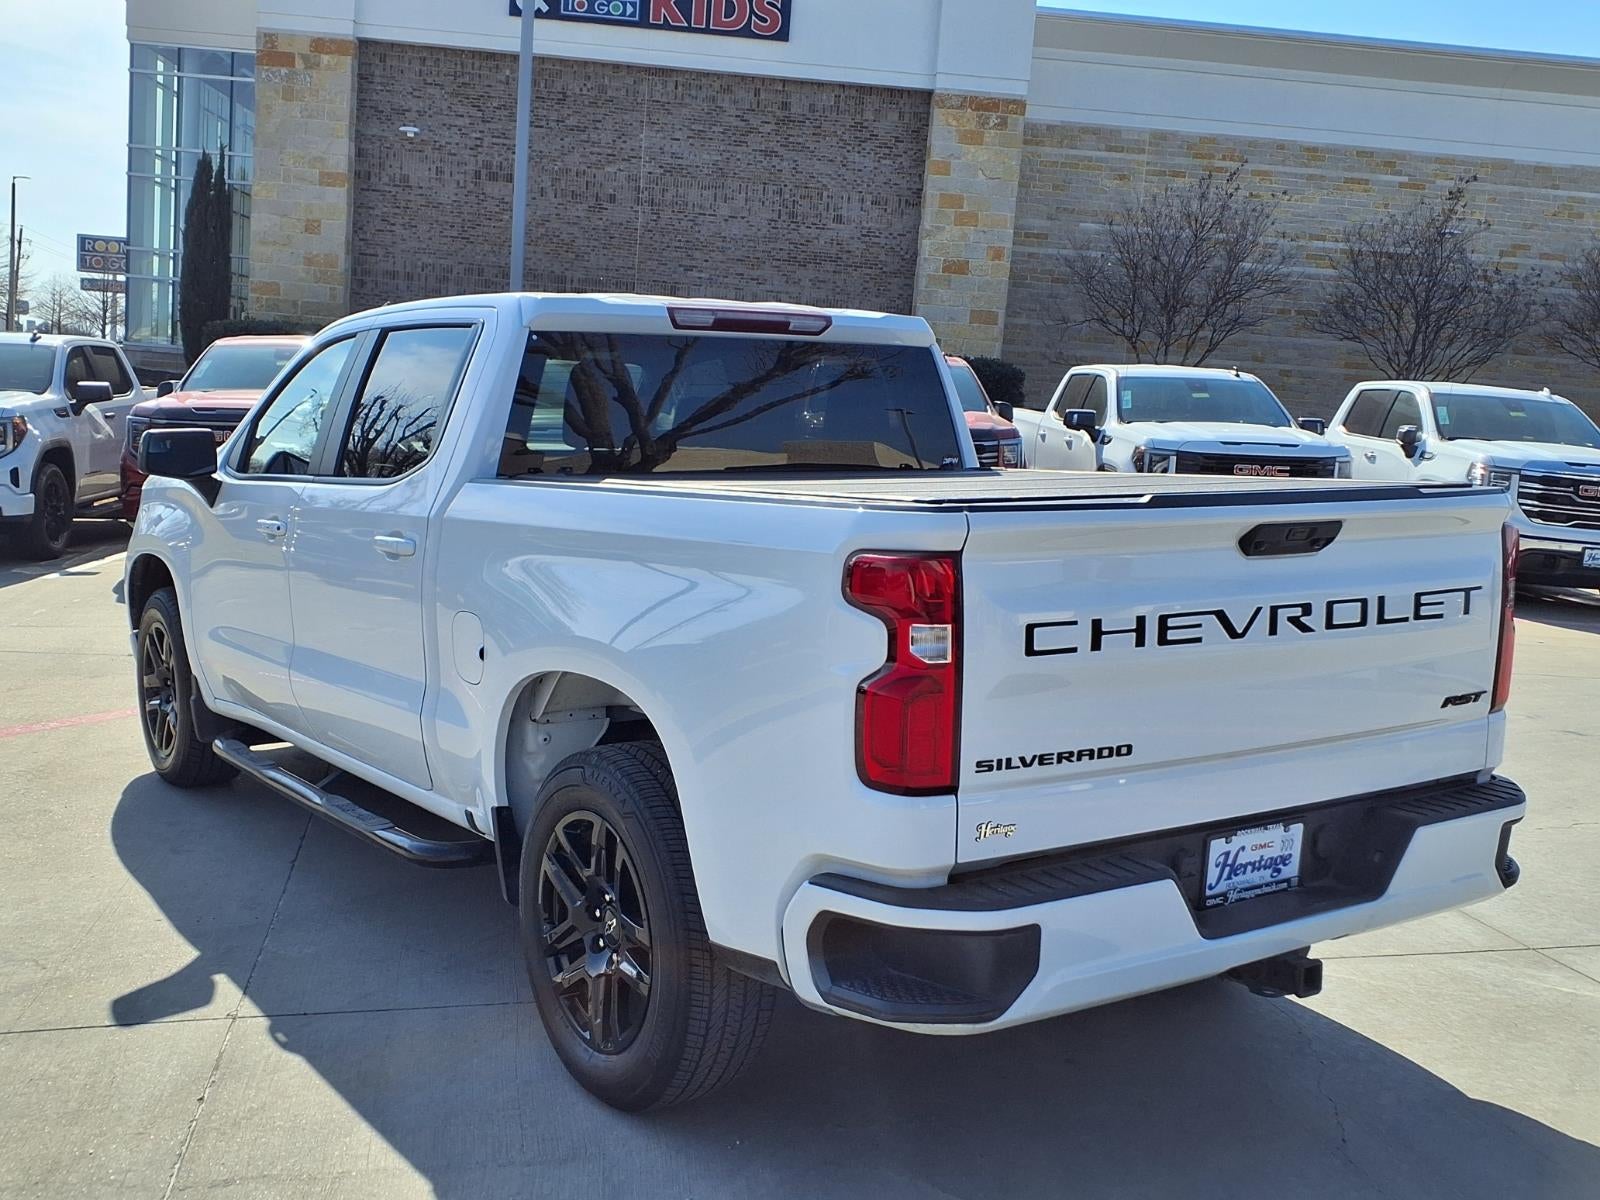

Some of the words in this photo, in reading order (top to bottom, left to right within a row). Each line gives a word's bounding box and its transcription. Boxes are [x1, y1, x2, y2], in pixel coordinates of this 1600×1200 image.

[594, 1, 624, 15] GO
[649, 0, 782, 36] KIDS
[84, 255, 104, 269] TO
[1233, 464, 1291, 477] GMC
[1024, 586, 1483, 657] CHEVROLET
[1440, 690, 1488, 708] RST
[975, 743, 1133, 774] SILVERADO
[975, 820, 1017, 842] Heritage
[1250, 841, 1275, 852] GMC
[1207, 845, 1293, 891] Heritage
